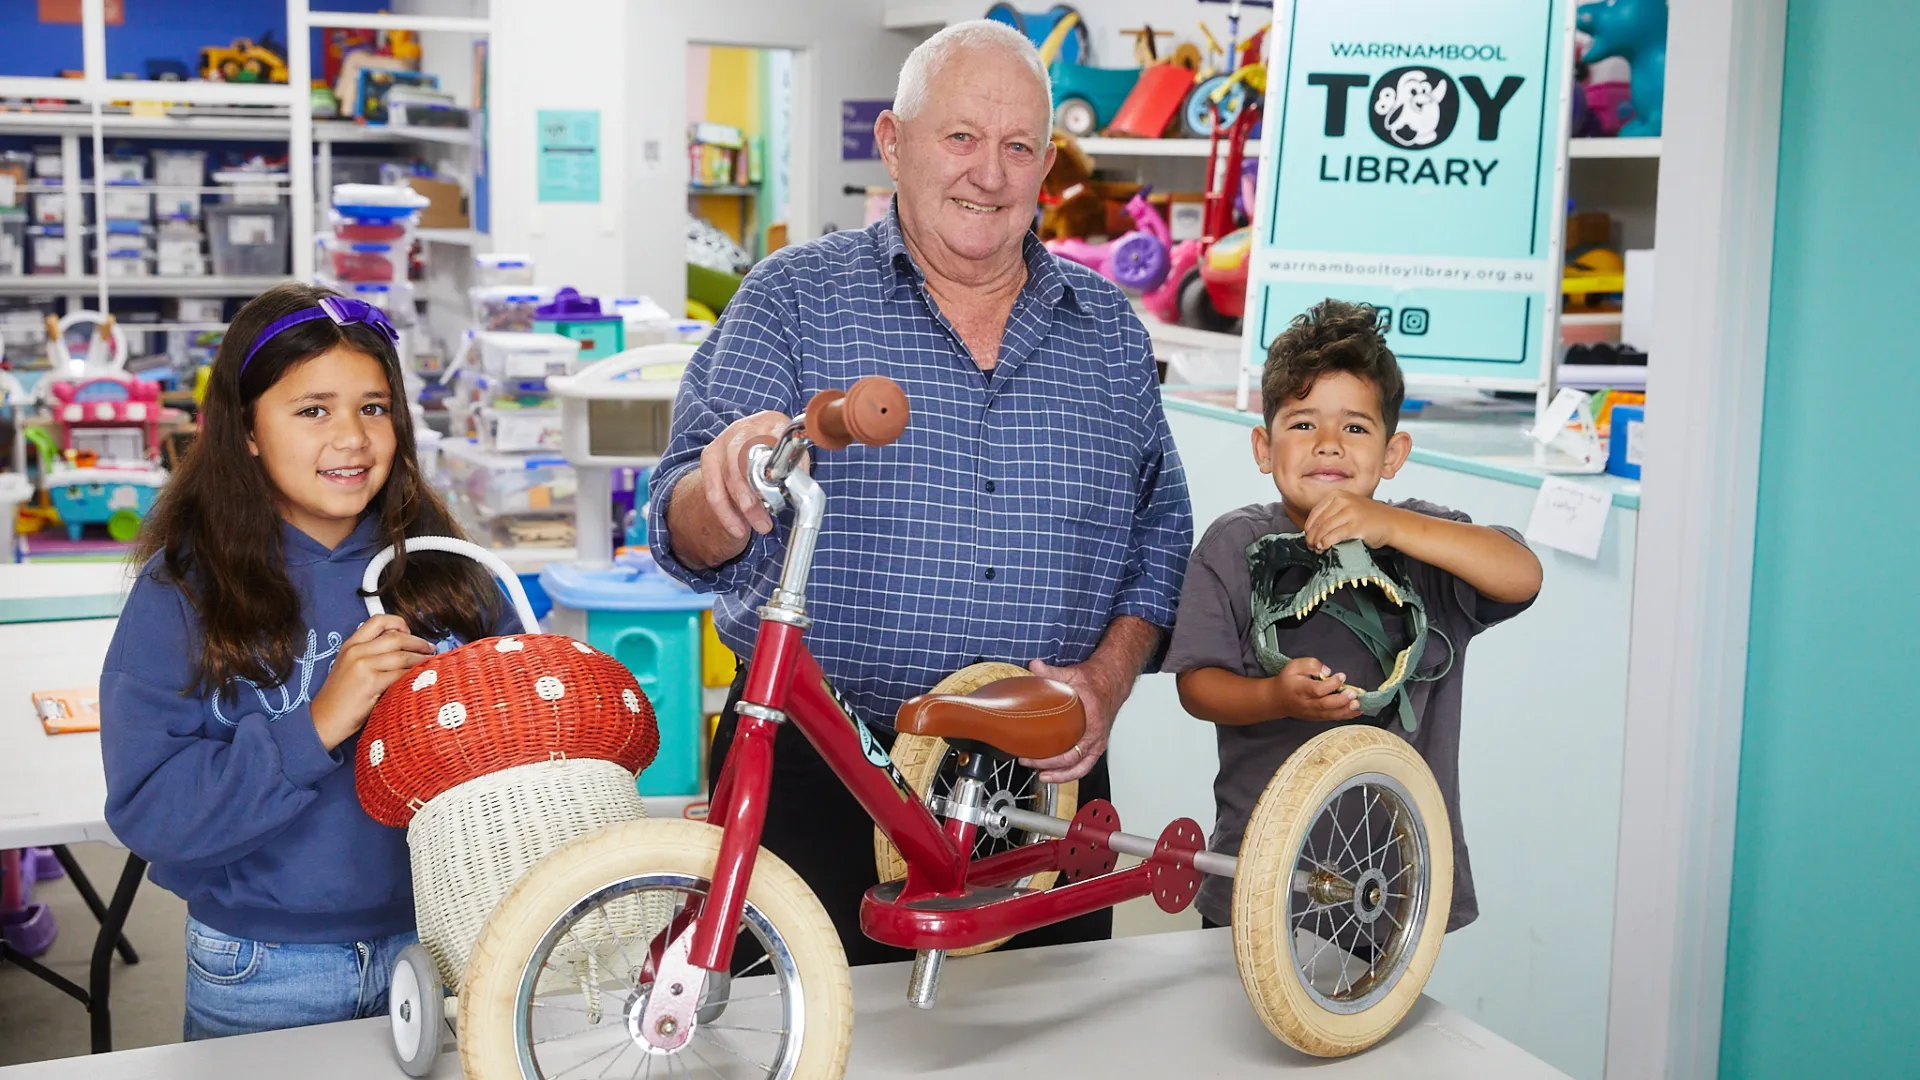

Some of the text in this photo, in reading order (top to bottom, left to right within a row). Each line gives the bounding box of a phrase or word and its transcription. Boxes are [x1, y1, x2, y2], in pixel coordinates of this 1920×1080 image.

[1331, 42, 1507, 61] WARRNAMBOOL
[1308, 65, 1525, 150] TOY
[1319, 154, 1498, 187] LIBRARY
[1269, 260, 1534, 281] warrnambooltoylibrary.org.au
